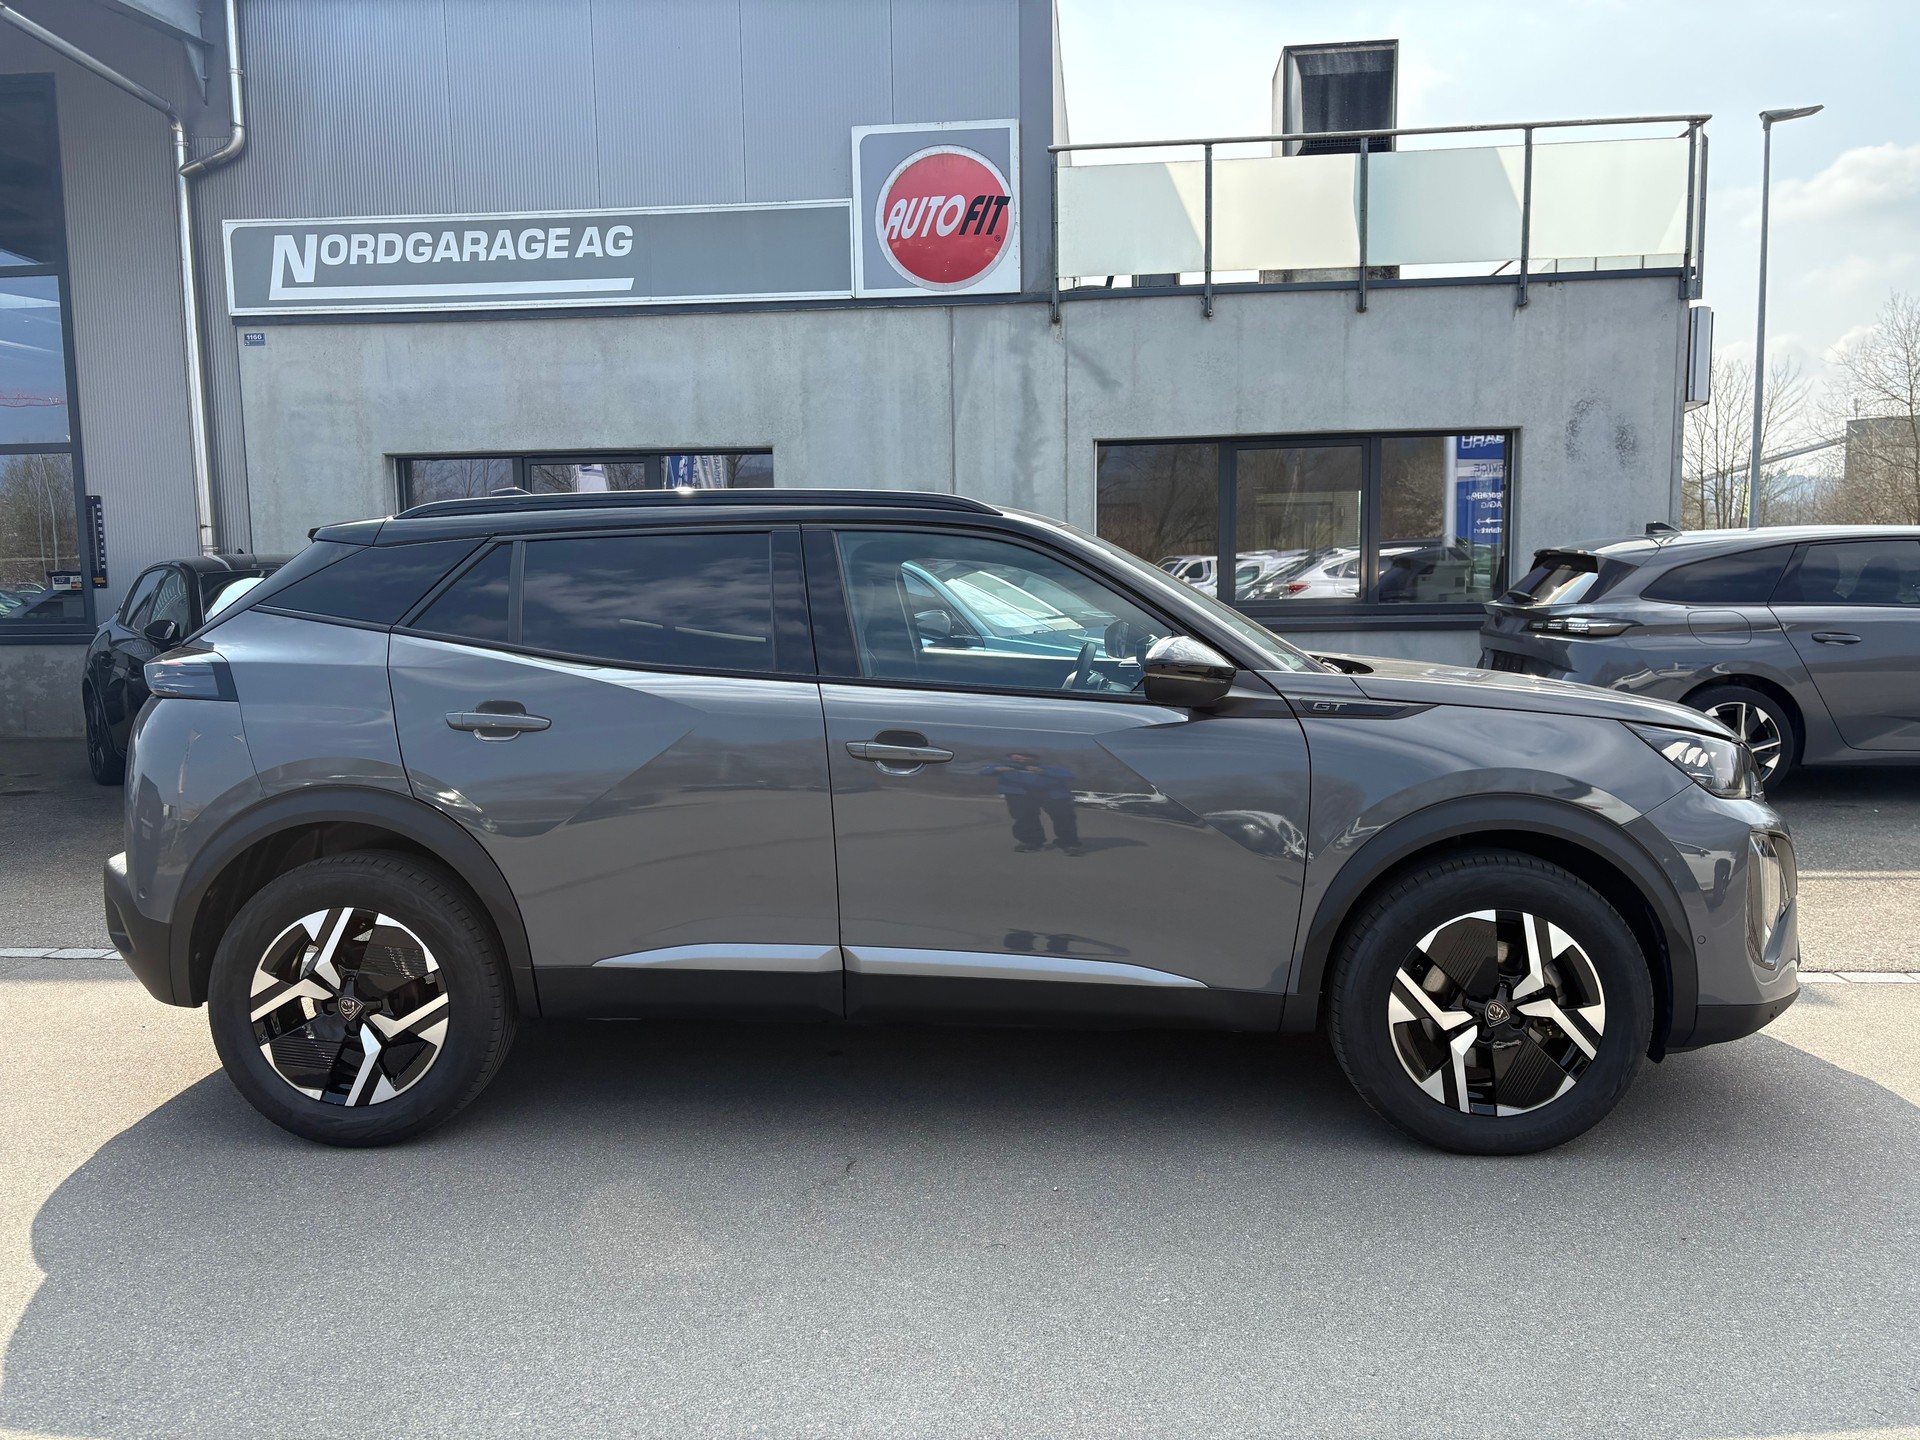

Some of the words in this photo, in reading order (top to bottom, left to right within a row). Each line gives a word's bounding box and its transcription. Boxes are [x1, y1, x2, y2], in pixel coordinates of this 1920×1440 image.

[885, 195, 1011, 240] AUTOFIT
[272, 228, 571, 285] NORDGARAGE
[575, 225, 633, 257] AG
[1312, 702, 1347, 711] GT
